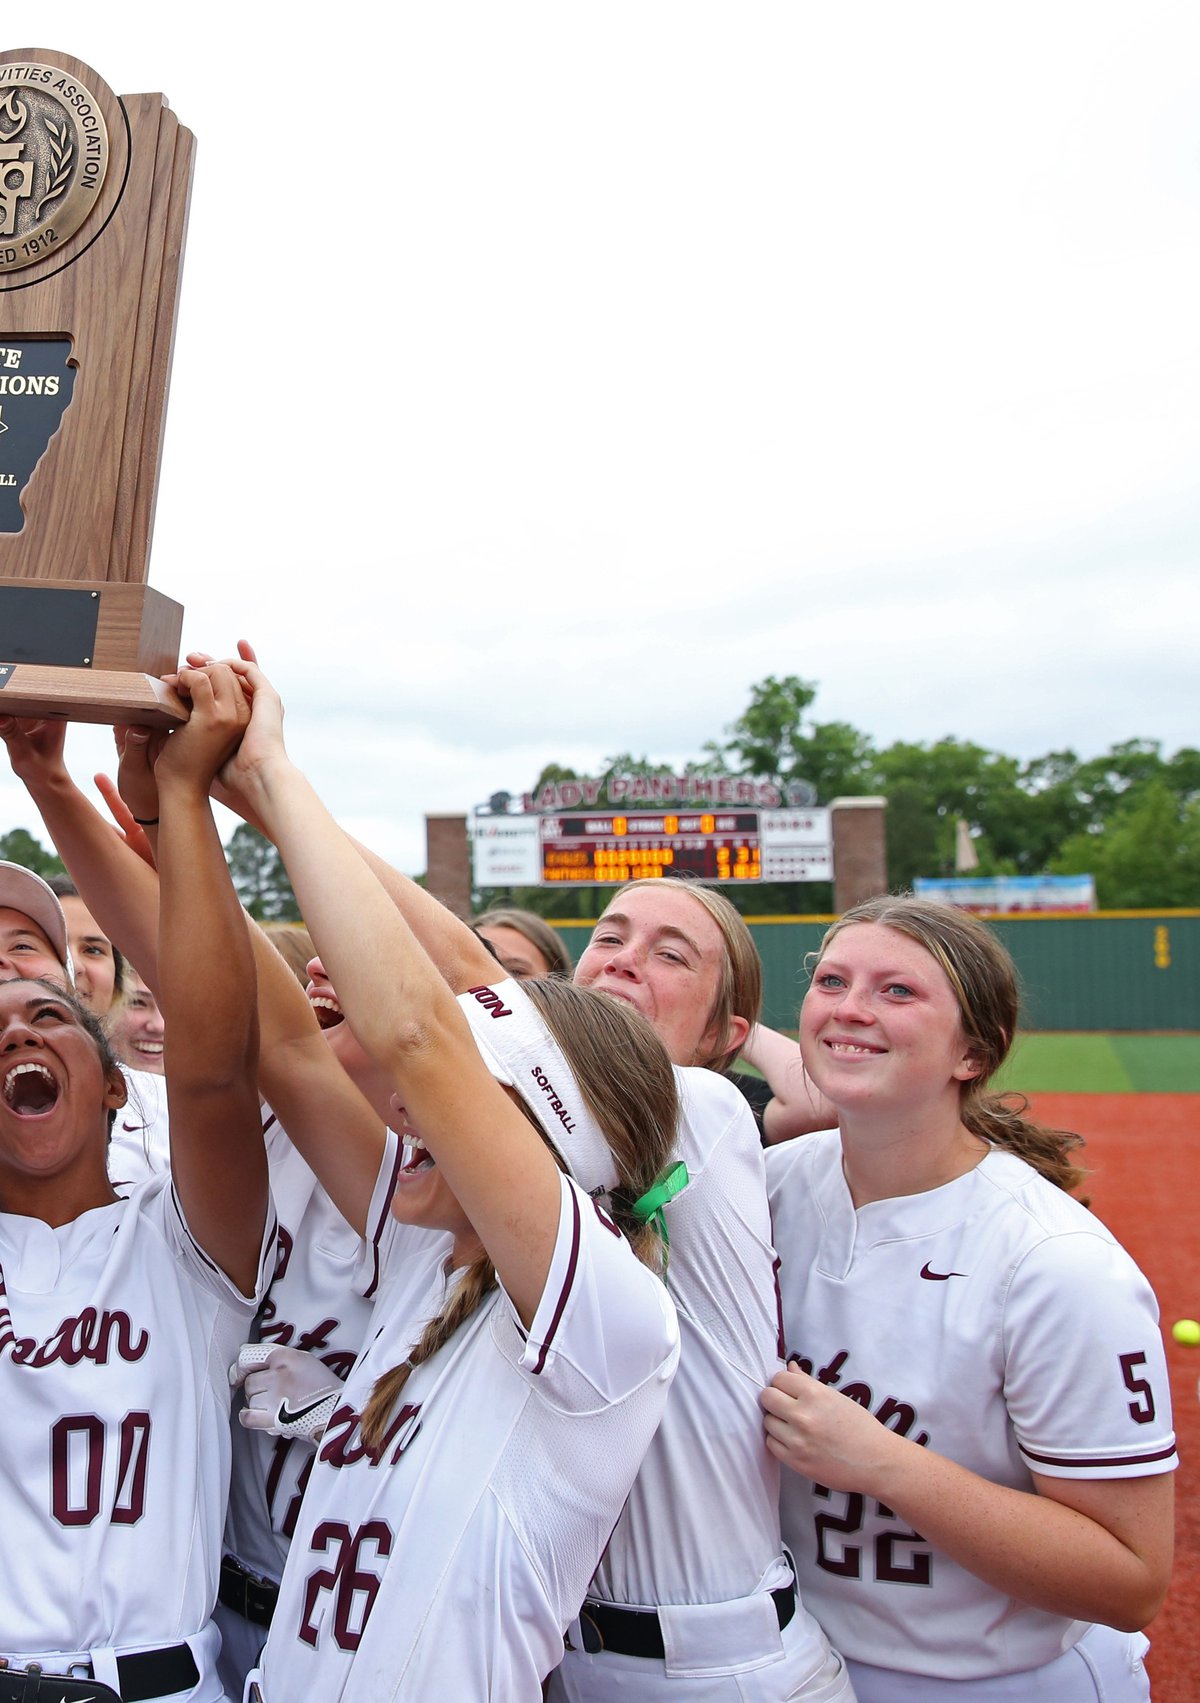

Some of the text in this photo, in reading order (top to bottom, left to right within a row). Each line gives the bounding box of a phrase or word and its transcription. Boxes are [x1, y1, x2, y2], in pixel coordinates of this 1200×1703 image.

[52, 78, 101, 189] ASSOCIATION
[21, 227, 60, 258] 1912
[522, 777, 782, 812] LADY PANTHERS
[531, 1066, 578, 1135] SOFTBALL
[49, 1408, 152, 1528] 00
[298, 1517, 394, 1653] 26
